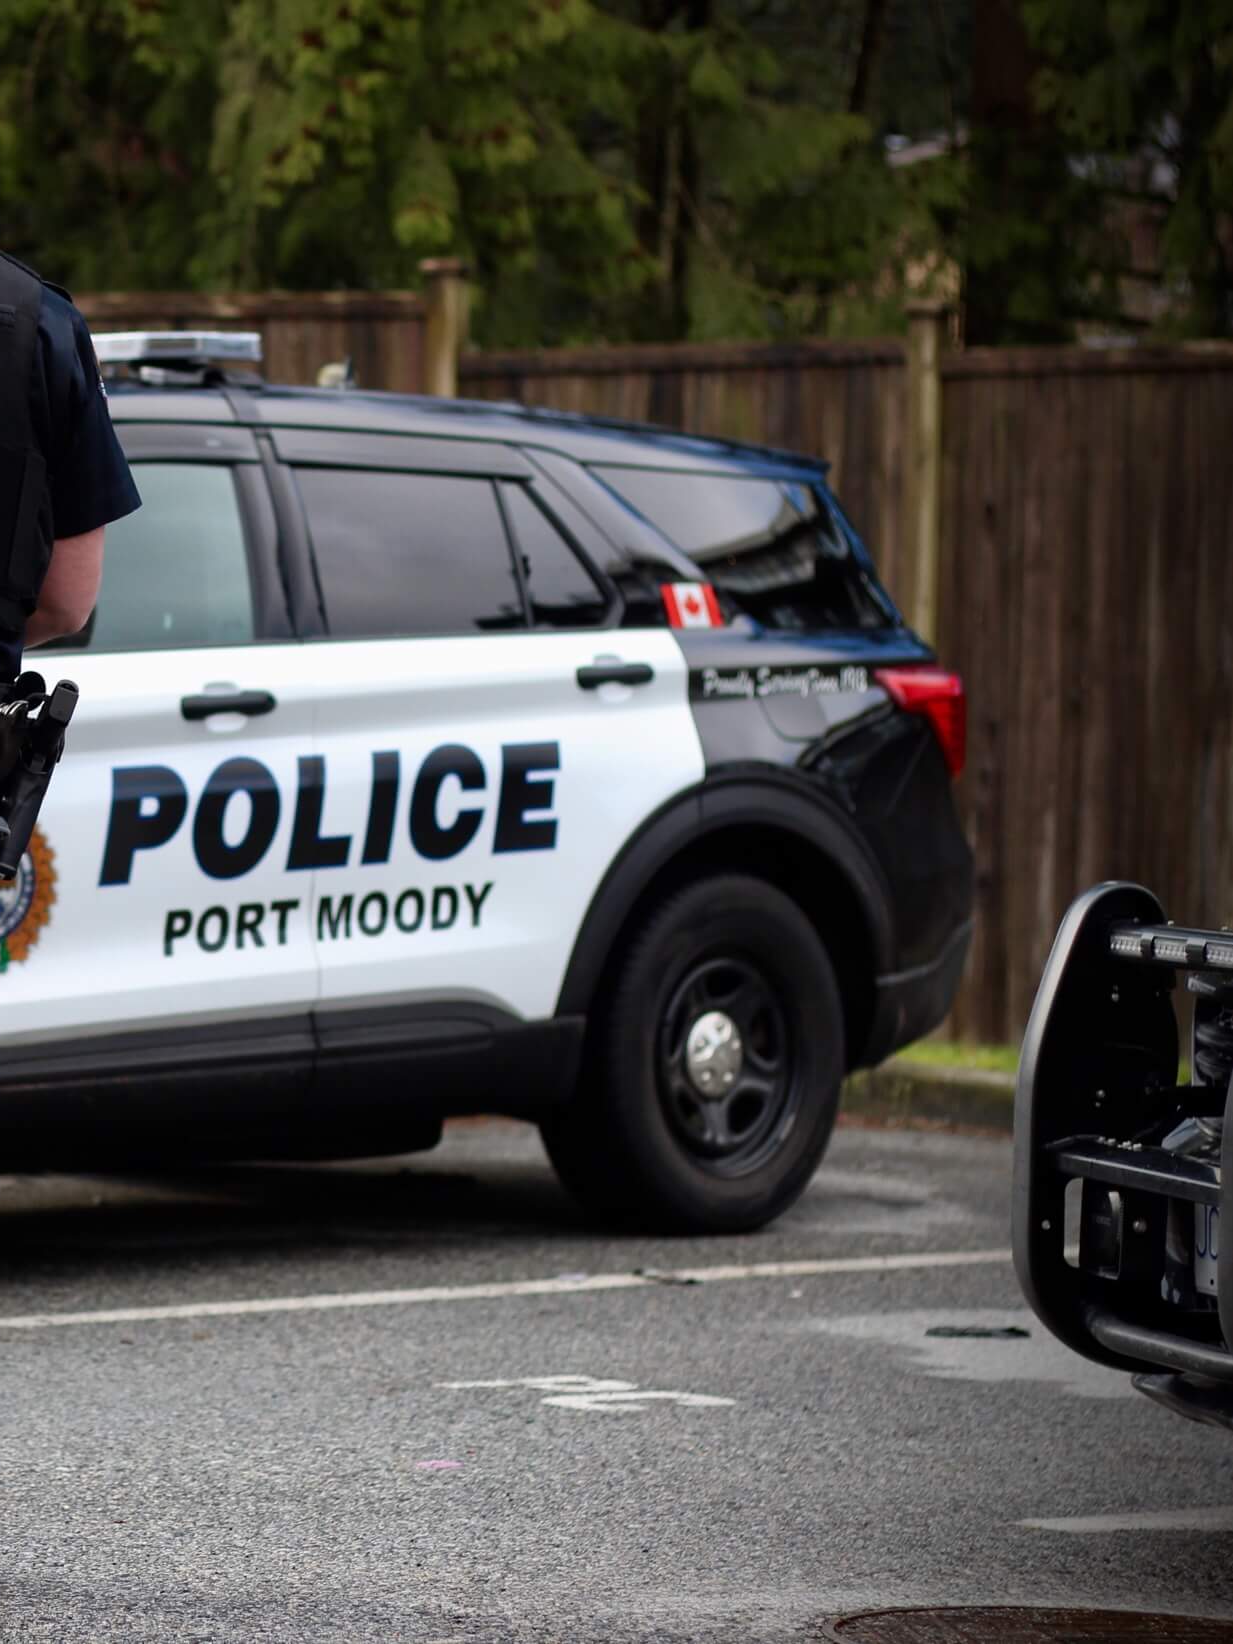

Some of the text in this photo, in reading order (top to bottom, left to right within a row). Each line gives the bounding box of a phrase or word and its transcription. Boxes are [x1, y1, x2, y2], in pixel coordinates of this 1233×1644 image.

[97, 740, 561, 887] POLICE
[162, 881, 495, 957] PORT MOODY
